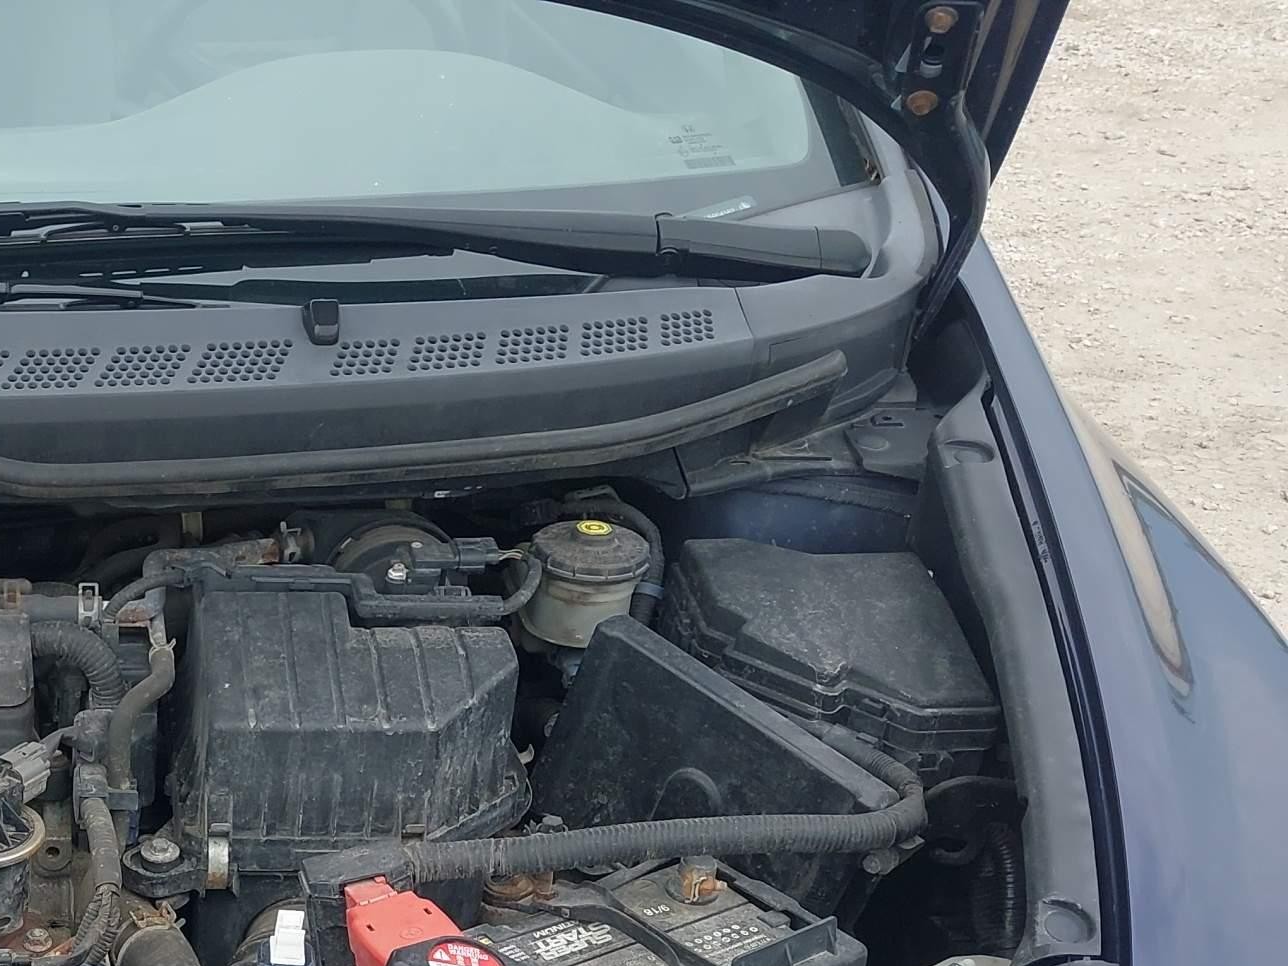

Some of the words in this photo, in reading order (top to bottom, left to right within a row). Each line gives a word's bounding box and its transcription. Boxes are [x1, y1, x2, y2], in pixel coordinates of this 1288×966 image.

[532, 920, 578, 939] TINUM
[534, 921, 610, 953] START
[539, 934, 612, 961] SUPER
